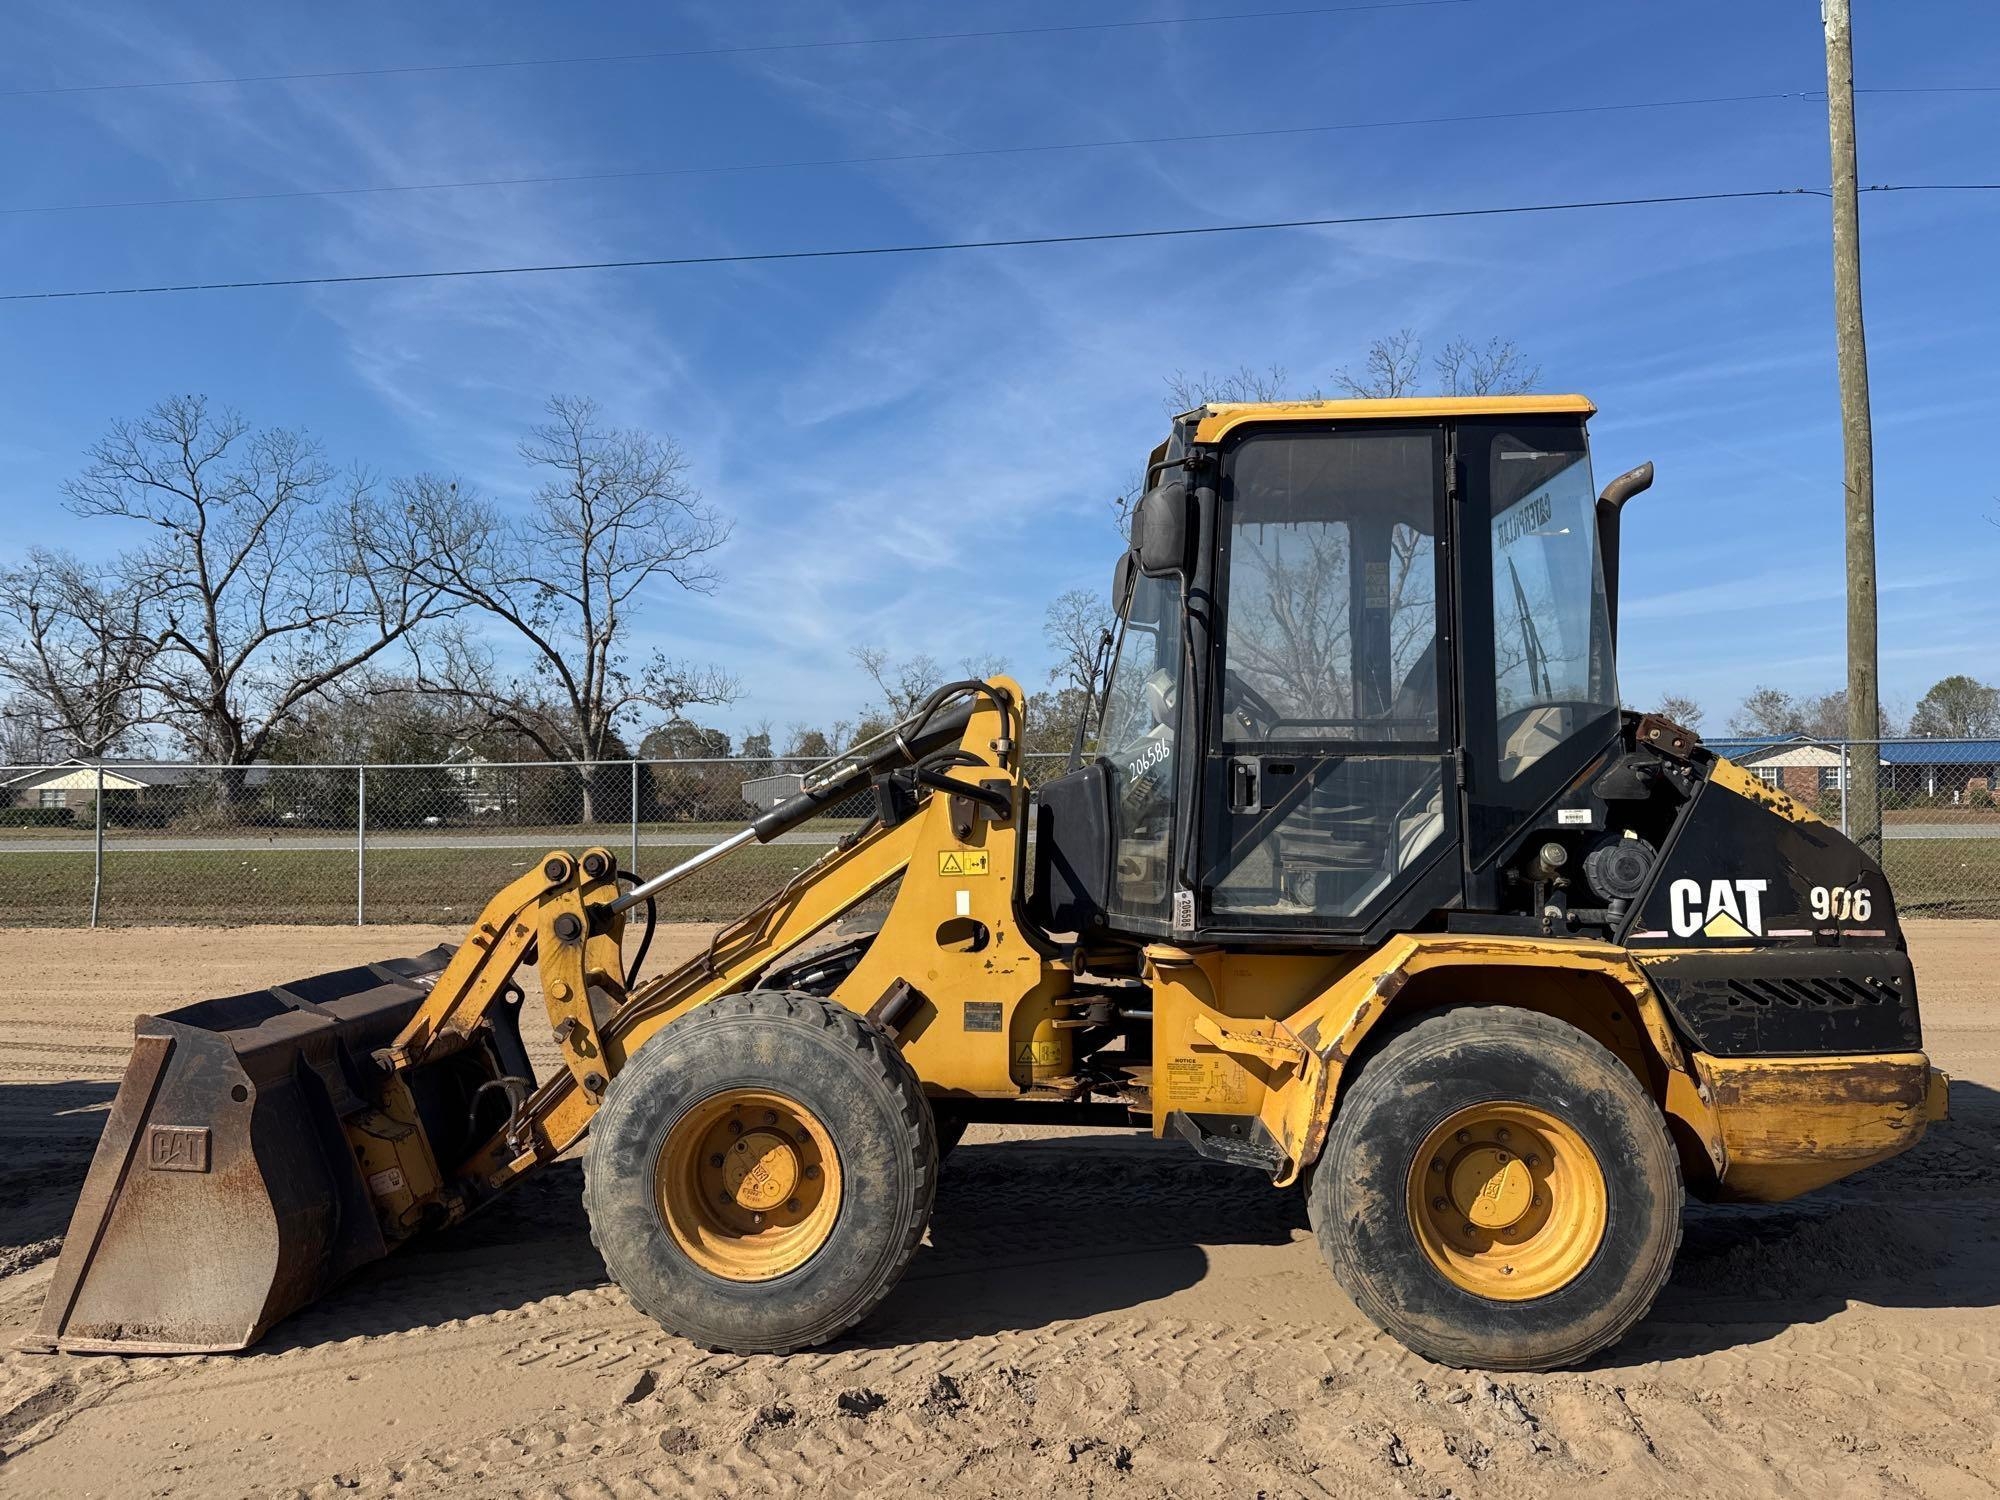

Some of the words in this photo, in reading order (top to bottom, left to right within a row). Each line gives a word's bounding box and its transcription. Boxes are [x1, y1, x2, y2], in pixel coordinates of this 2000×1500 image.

[1129, 737, 1170, 783] 206586
[1181, 899, 1192, 927] 206586
[1669, 878, 1768, 937] CAT
[1810, 886, 1872, 921] 906
[152, 1131, 204, 1165] CAT
